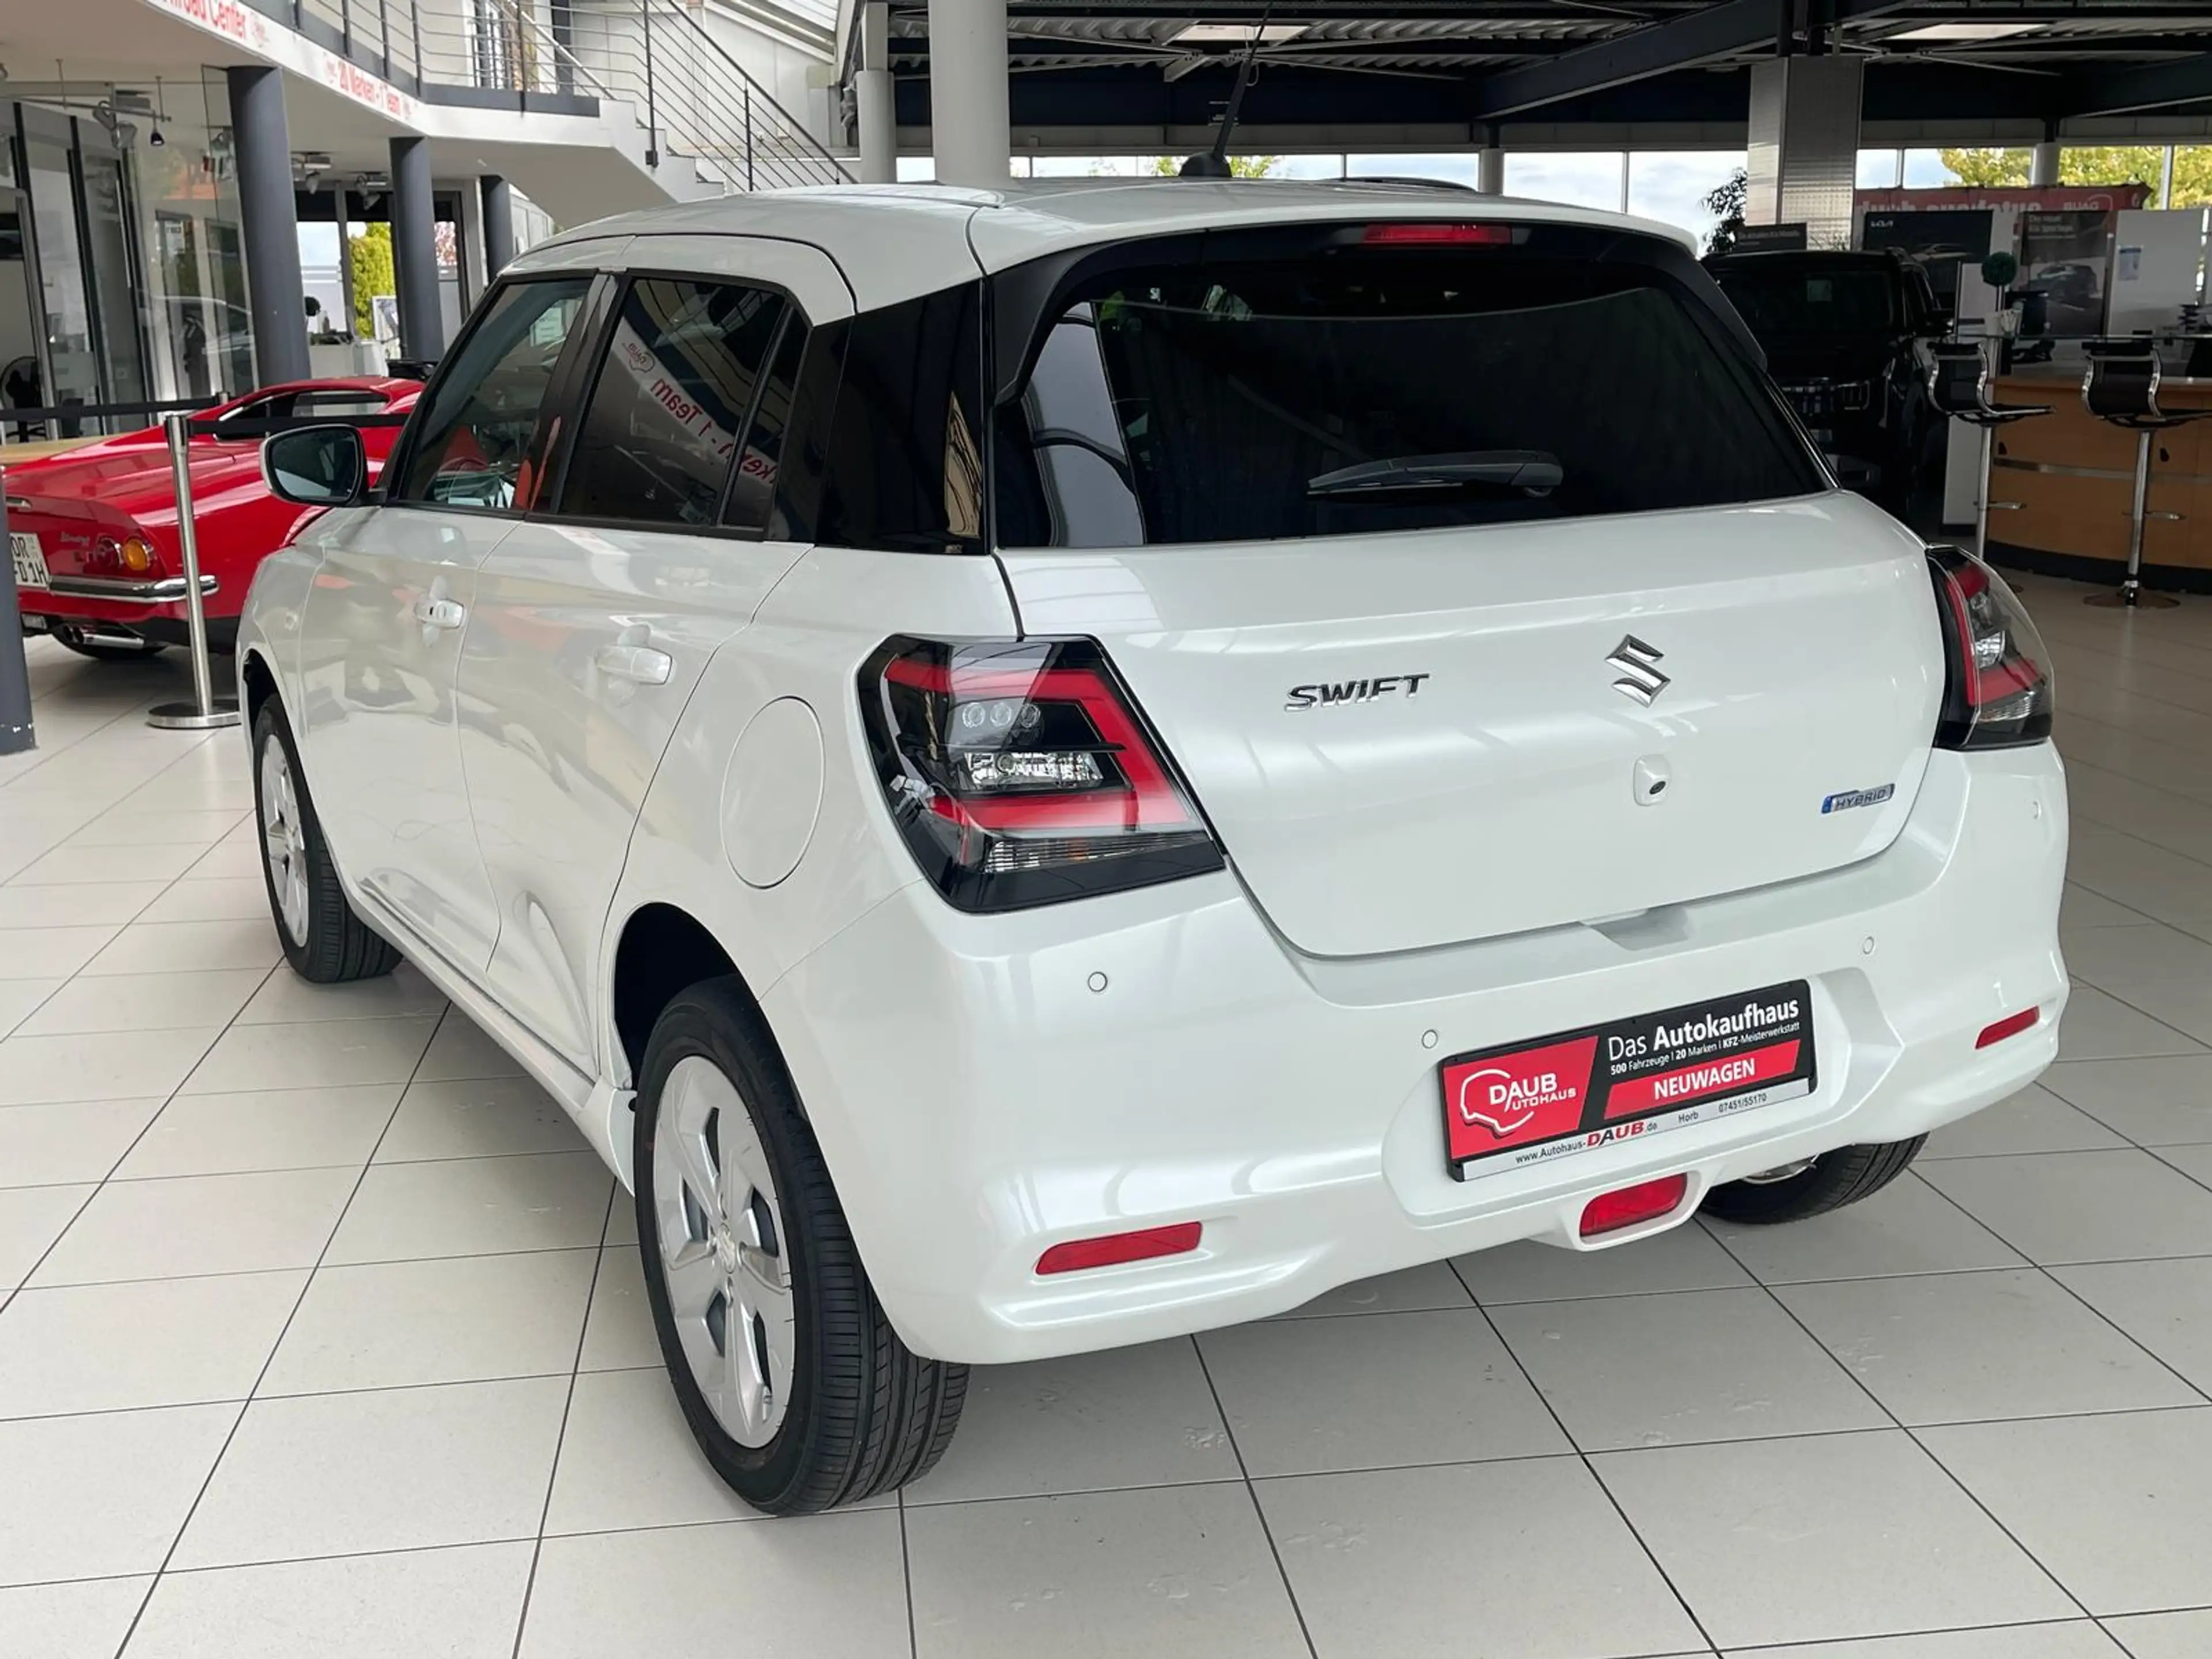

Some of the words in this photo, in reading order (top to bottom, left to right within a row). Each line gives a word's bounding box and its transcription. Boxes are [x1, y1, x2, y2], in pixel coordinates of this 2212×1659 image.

[1284, 673, 1430, 712] SWIFT
[1835, 789, 1887, 809] HYBRID
[1608, 1035, 1647, 1061] Das
[1653, 999, 1799, 1051] Autokaufhaus
[1611, 1065, 1627, 1075] 500
[1628, 1054, 1669, 1071] Fahrzeuge
[1675, 1049, 1687, 1060] 20
[1688, 1043, 1717, 1057] Marken
[1722, 1021, 1800, 1050] KFZ-Meisterwerkstatt
[1489, 1073, 1558, 1112] DAUB
[1654, 1058, 1755, 1100] NEUWAGEN
[1515, 1120, 1658, 1164] www.Autohaus-DAUB.de
[1678, 1111, 1699, 1124] Horb
[1718, 1093, 1767, 1113] 07451/55170
